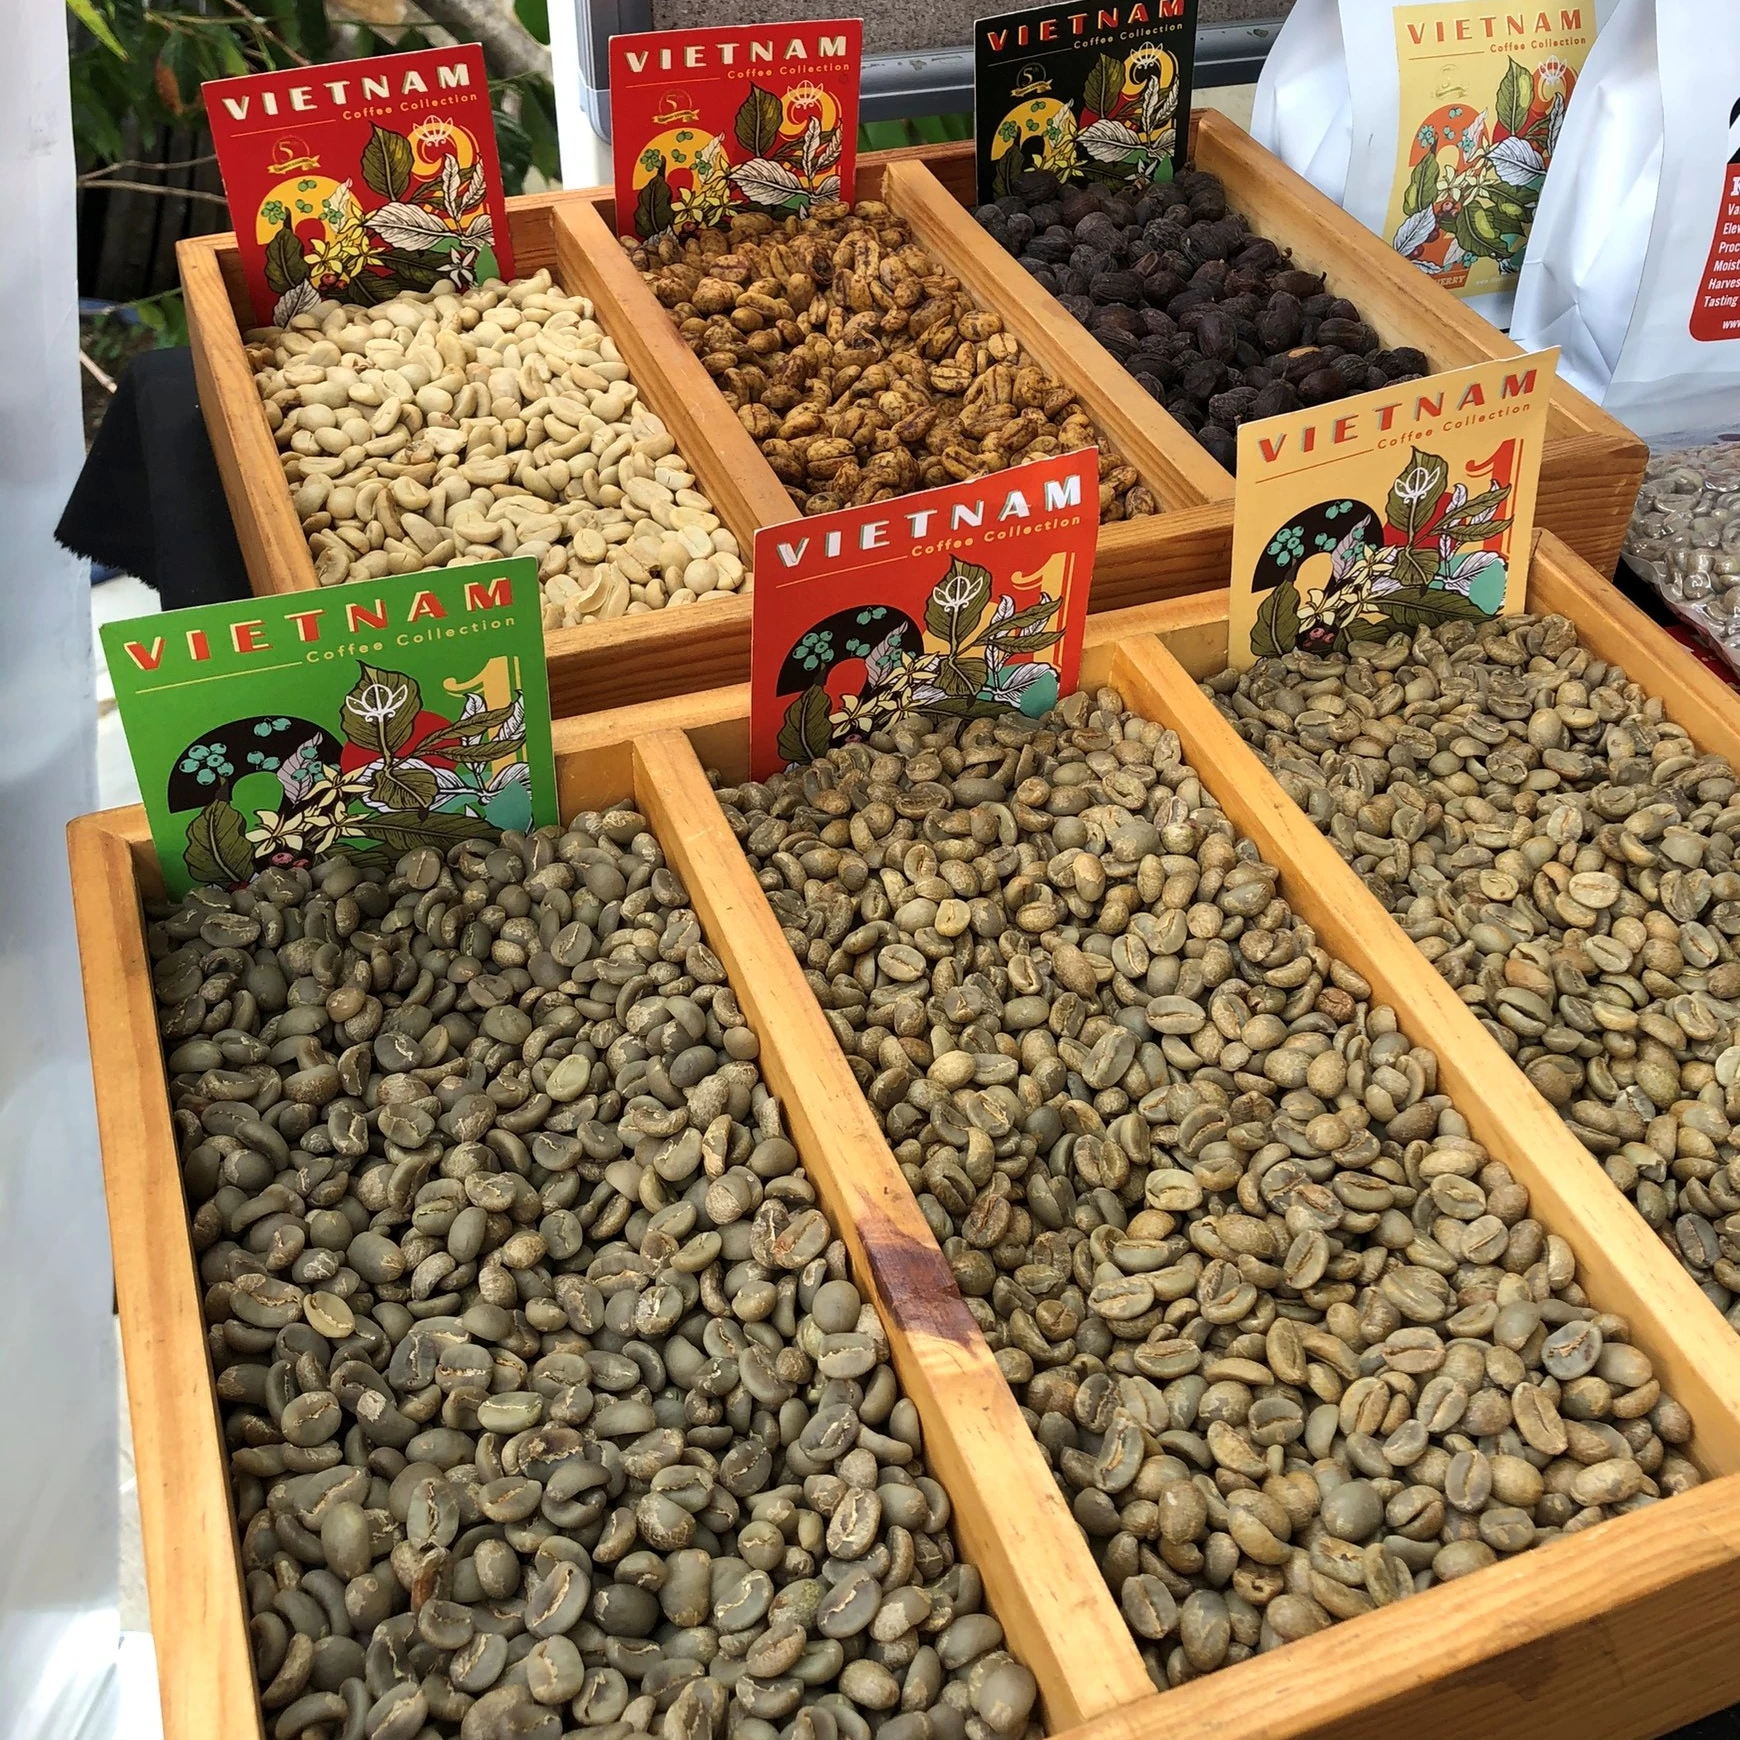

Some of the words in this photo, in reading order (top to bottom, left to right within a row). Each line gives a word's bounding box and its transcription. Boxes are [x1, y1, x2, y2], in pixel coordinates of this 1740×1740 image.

[986, 0, 1184, 51] VIETNAM
[1073, 35, 1113, 49] Coffee
[1120, 23, 1183, 40] Collection
[1407, 8, 1582, 44] VIETNAM
[1490, 42, 1525, 53] Coffee
[1531, 37, 1586, 49] Collection
[624, 35, 847, 73] VIETNAM
[727, 68, 773, 80] Coffee
[779, 62, 850, 75] Collection
[222, 63, 471, 121] VIETNAM
[342, 106, 393, 121] Coffee
[400, 92, 478, 112] Collection
[1727, 203, 1740, 216] Va
[1704, 295, 1739, 308] Tasting
[1258, 369, 1537, 463] VIETNAM
[1377, 429, 1433, 450] Coffee
[1443, 403, 1530, 432] Collection
[776, 474, 1081, 568] VIETNAM
[911, 537, 974, 557] Coffee
[984, 515, 1080, 542] Collection
[123, 577, 513, 671] VIETNAM
[306, 641, 384, 664] Coffee
[396, 616, 515, 646] Collection
